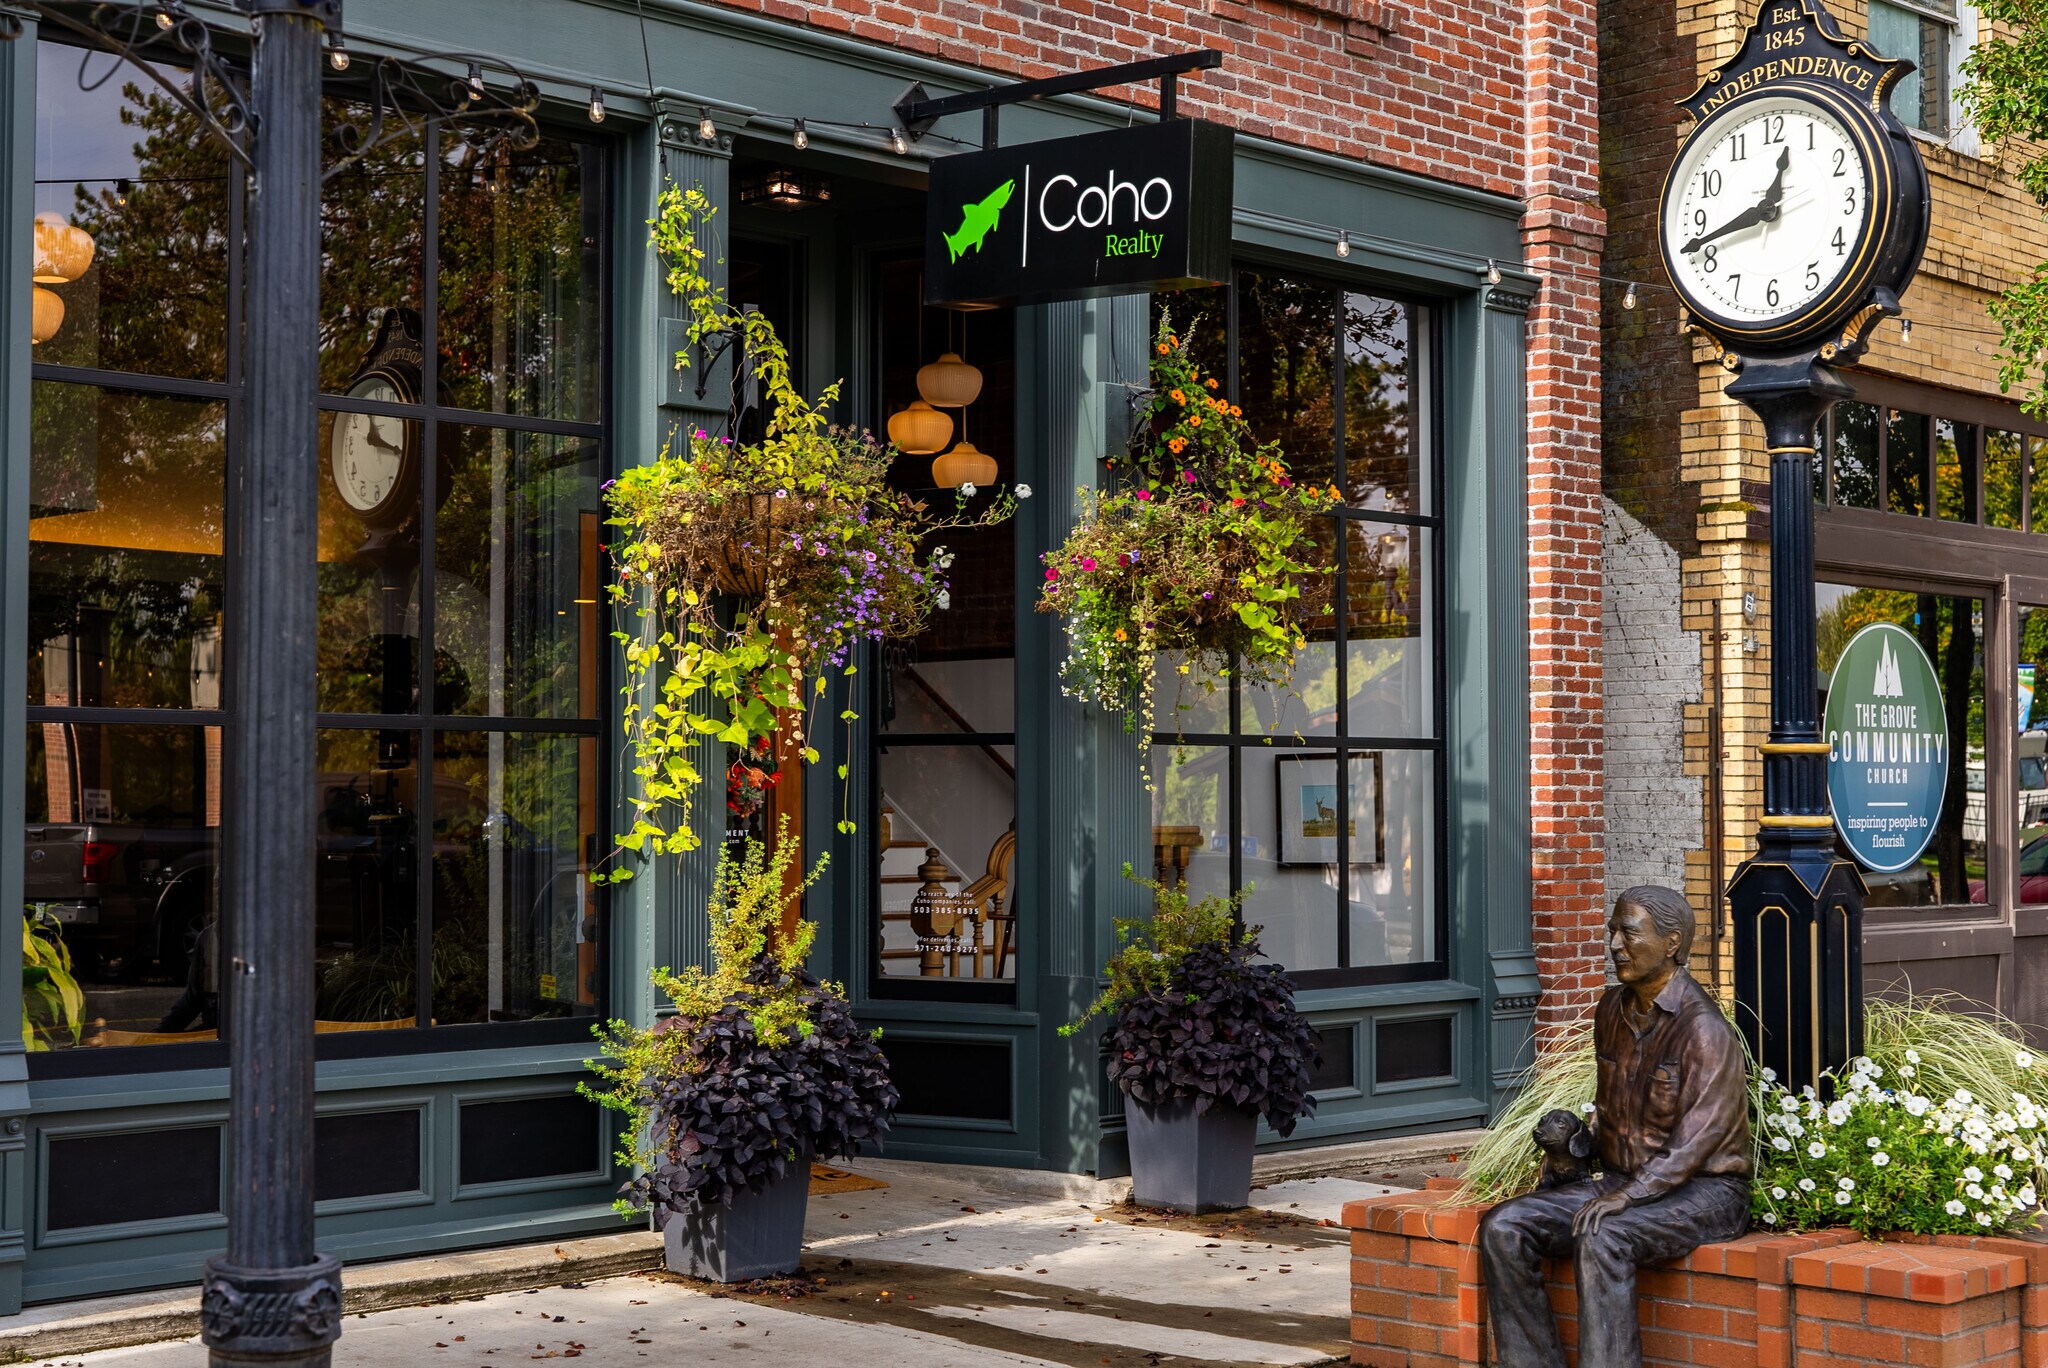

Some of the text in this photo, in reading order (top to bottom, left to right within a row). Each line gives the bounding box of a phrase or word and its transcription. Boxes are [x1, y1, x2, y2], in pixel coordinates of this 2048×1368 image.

[1772, 7, 1801, 25] Est.
[1764, 27, 1805, 51] 1845
[1699, 56, 1873, 116] INDEPENDENCE
[1762, 115, 1786, 145] 12
[1807, 122, 1816, 150] 1
[1730, 133, 1747, 162] 11
[1832, 148, 1847, 177] 2
[1701, 169, 1722, 199] 10
[1039, 169, 1173, 232] Coho
[1844, 187, 1856, 215] 3
[1694, 209, 1706, 236] 9
[1105, 229, 1164, 259] Realty
[1831, 226, 1846, 256] 4
[1703, 244, 1717, 273] 8
[1726, 273, 1741, 302] 7
[1805, 260, 1819, 291] 5
[1766, 279, 1779, 307] 6
[1855, 704, 1917, 729] THE GROVE
[1829, 730, 1944, 763] COMMUNITY
[1867, 768, 1908, 784] CHURCH
[1848, 814, 1927, 832] inspiring people to
[1872, 834, 1905, 848] flourish
[914, 907, 979, 915] 503-385-8835
[914, 945, 978, 953] 971-240-9275
